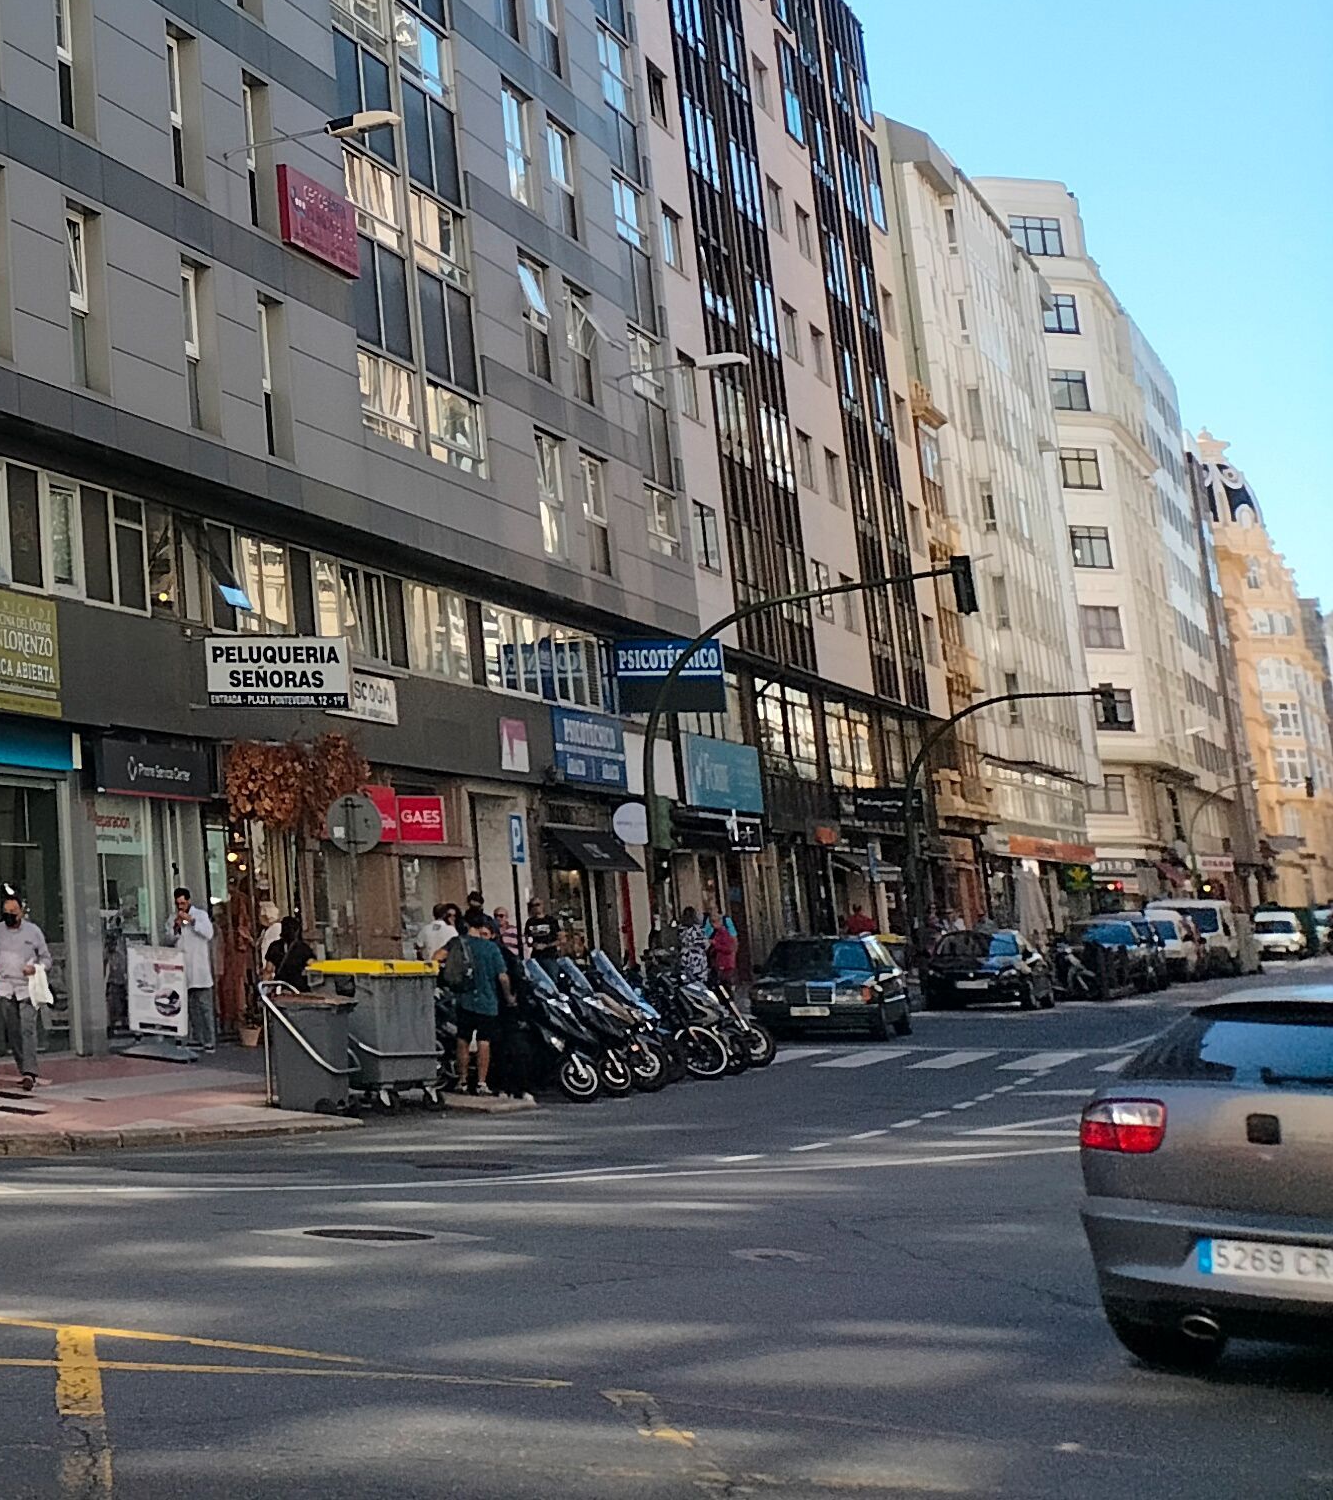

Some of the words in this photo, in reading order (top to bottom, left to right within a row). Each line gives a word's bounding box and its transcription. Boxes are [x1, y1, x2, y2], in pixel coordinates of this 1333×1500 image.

[16, 617, 29, 630] DEL
[29, 618, 52, 634] DOLOR
[211, 646, 340, 664] PELUQUERIA
[16, 663, 56, 684] ABIERTA
[229, 665, 324, 688] SEÑORAS
[211, 694, 242, 705] ENTRADA
[247, 695, 269, 705] PLAZA
[318, 696, 327, 705] 12
[400, 809, 440, 823] GAES
[1216, 1244, 1285, 1274] 5269
[1294, 1250, 1333, 1280] CR
